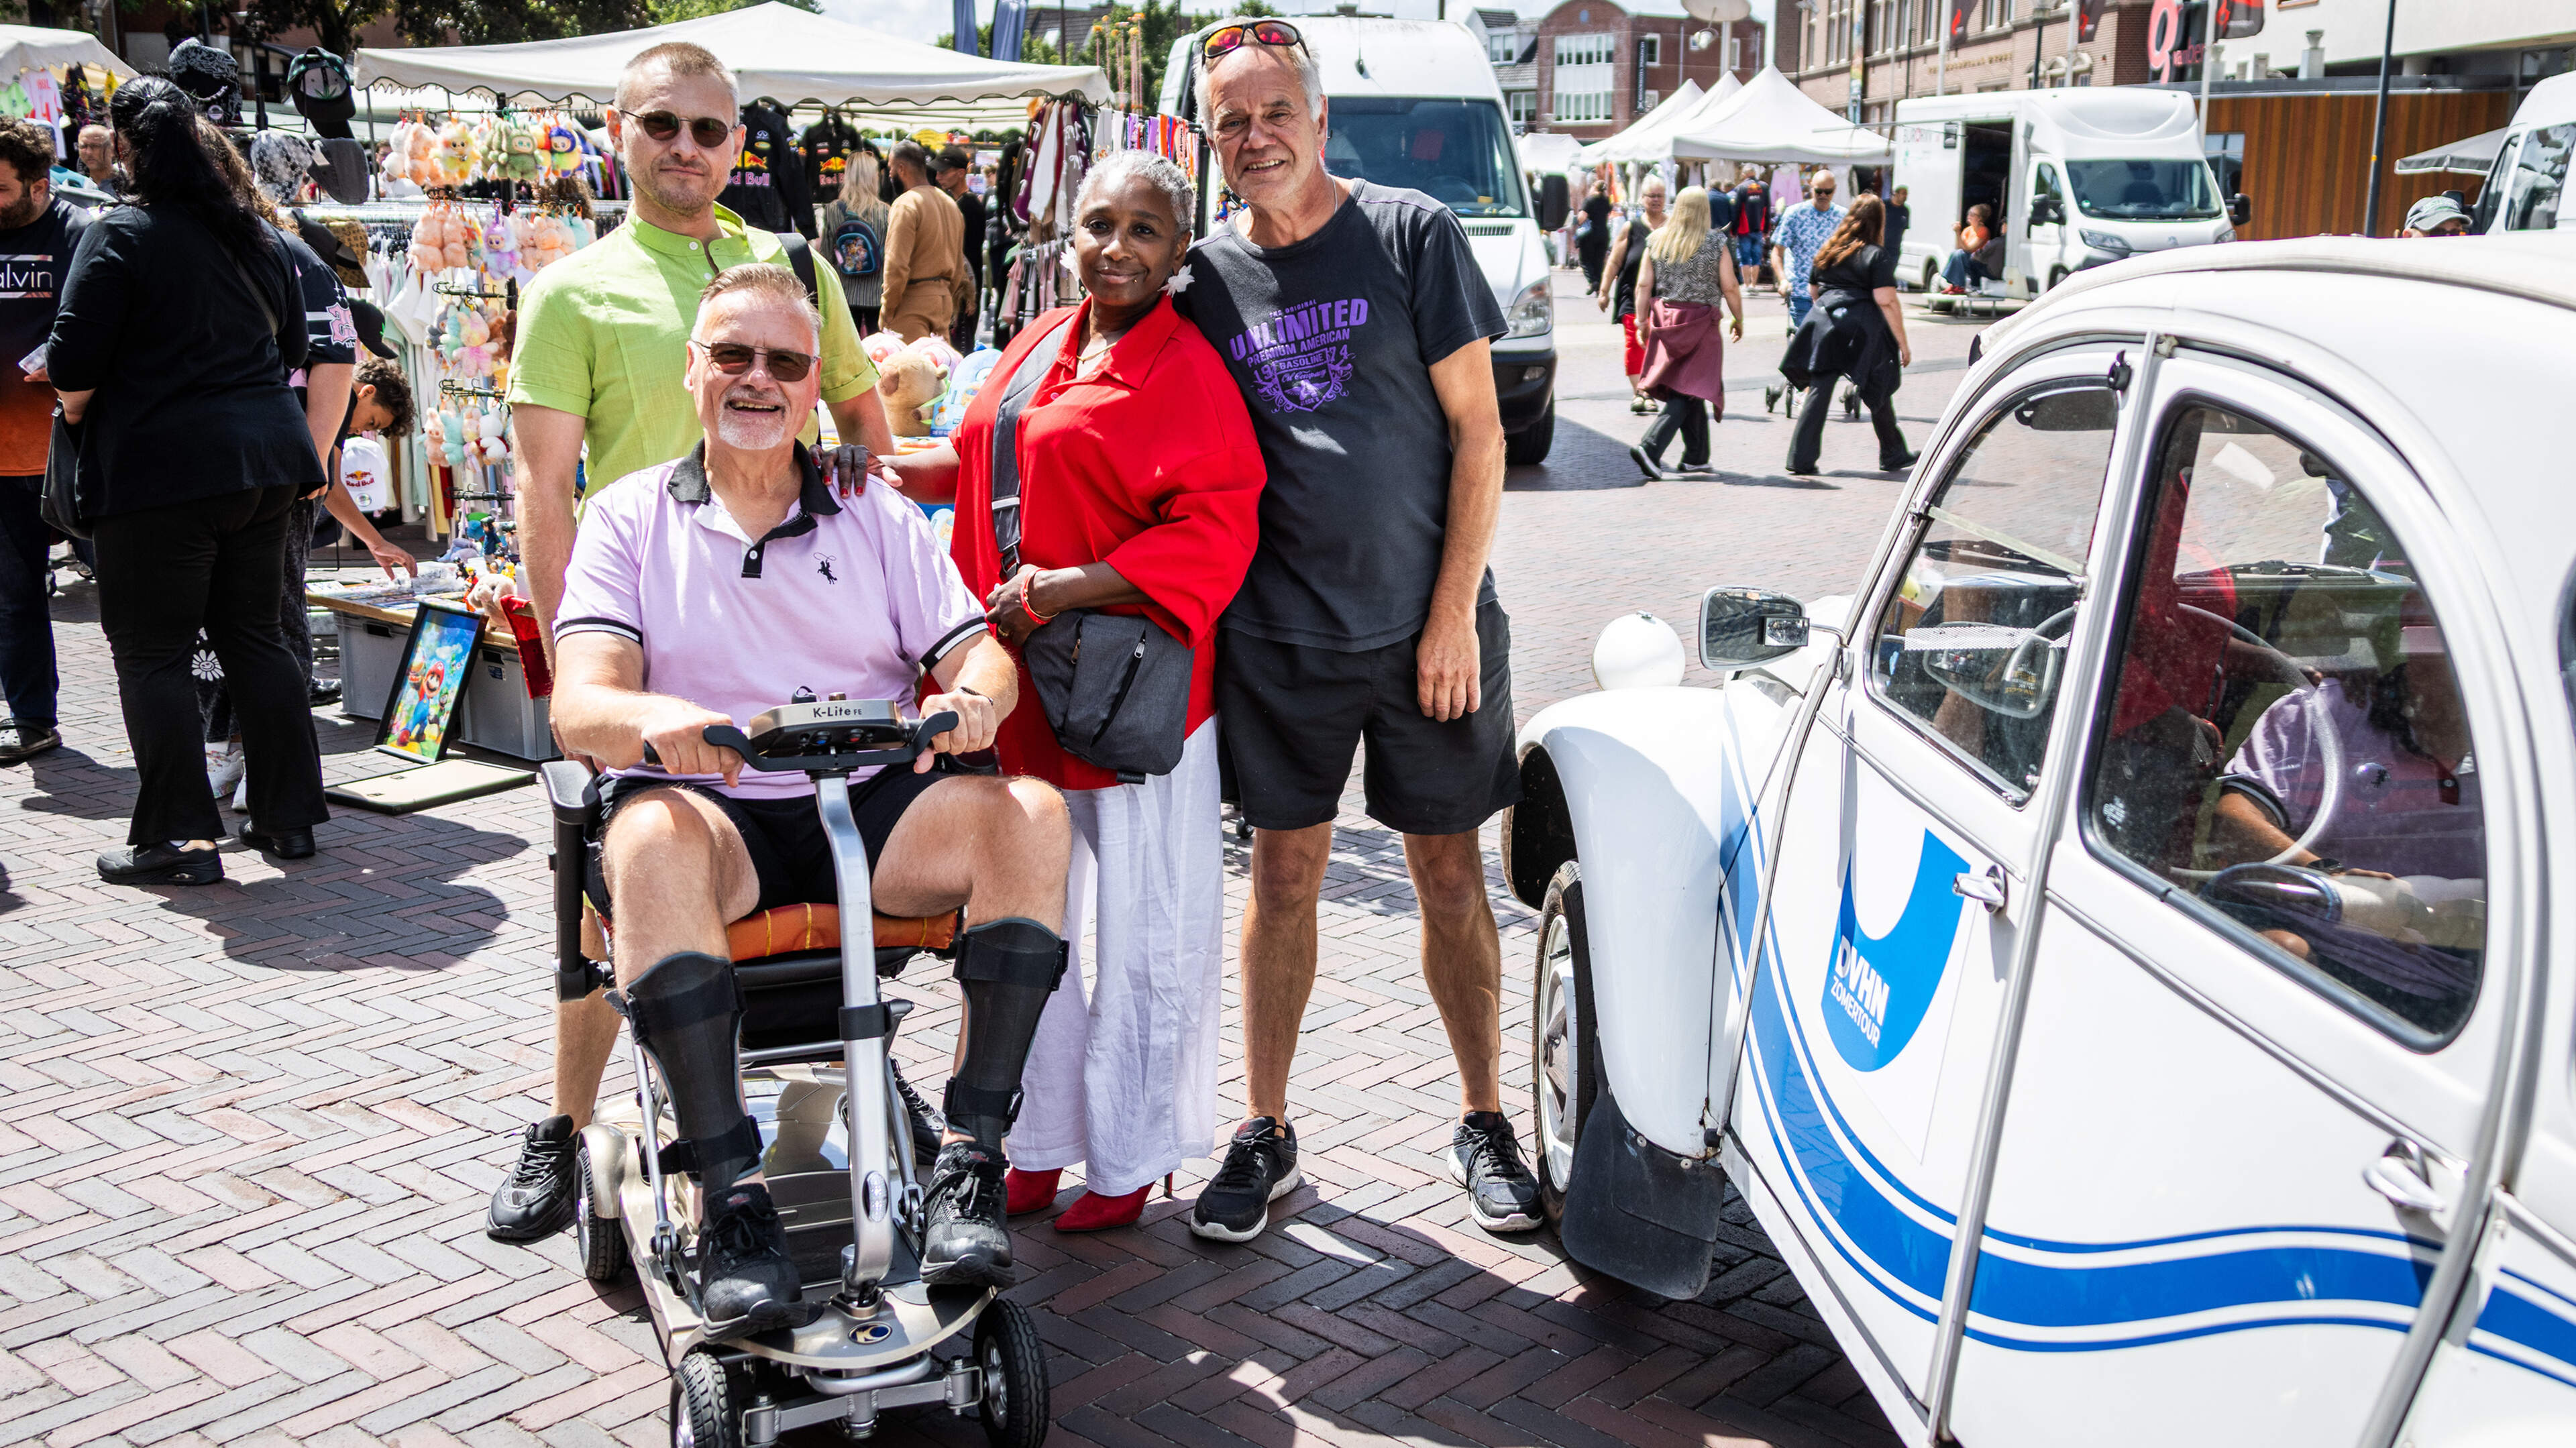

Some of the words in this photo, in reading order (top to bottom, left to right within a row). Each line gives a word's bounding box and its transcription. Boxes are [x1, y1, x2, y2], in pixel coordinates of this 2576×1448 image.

[745, 171, 769, 186] Bull
[1285, 299, 1317, 314] ORIGINAL
[1229, 298, 1369, 361] UNLIMITED
[1246, 344, 1297, 368] PREMIUM
[1300, 328, 1350, 353] AMERICAN
[362, 477, 374, 486] Bull
[813, 706, 851, 718] K-Lite
[1835, 934, 1890, 1027] DVHN
[1830, 974, 1881, 1049] ZOMERTOUR
